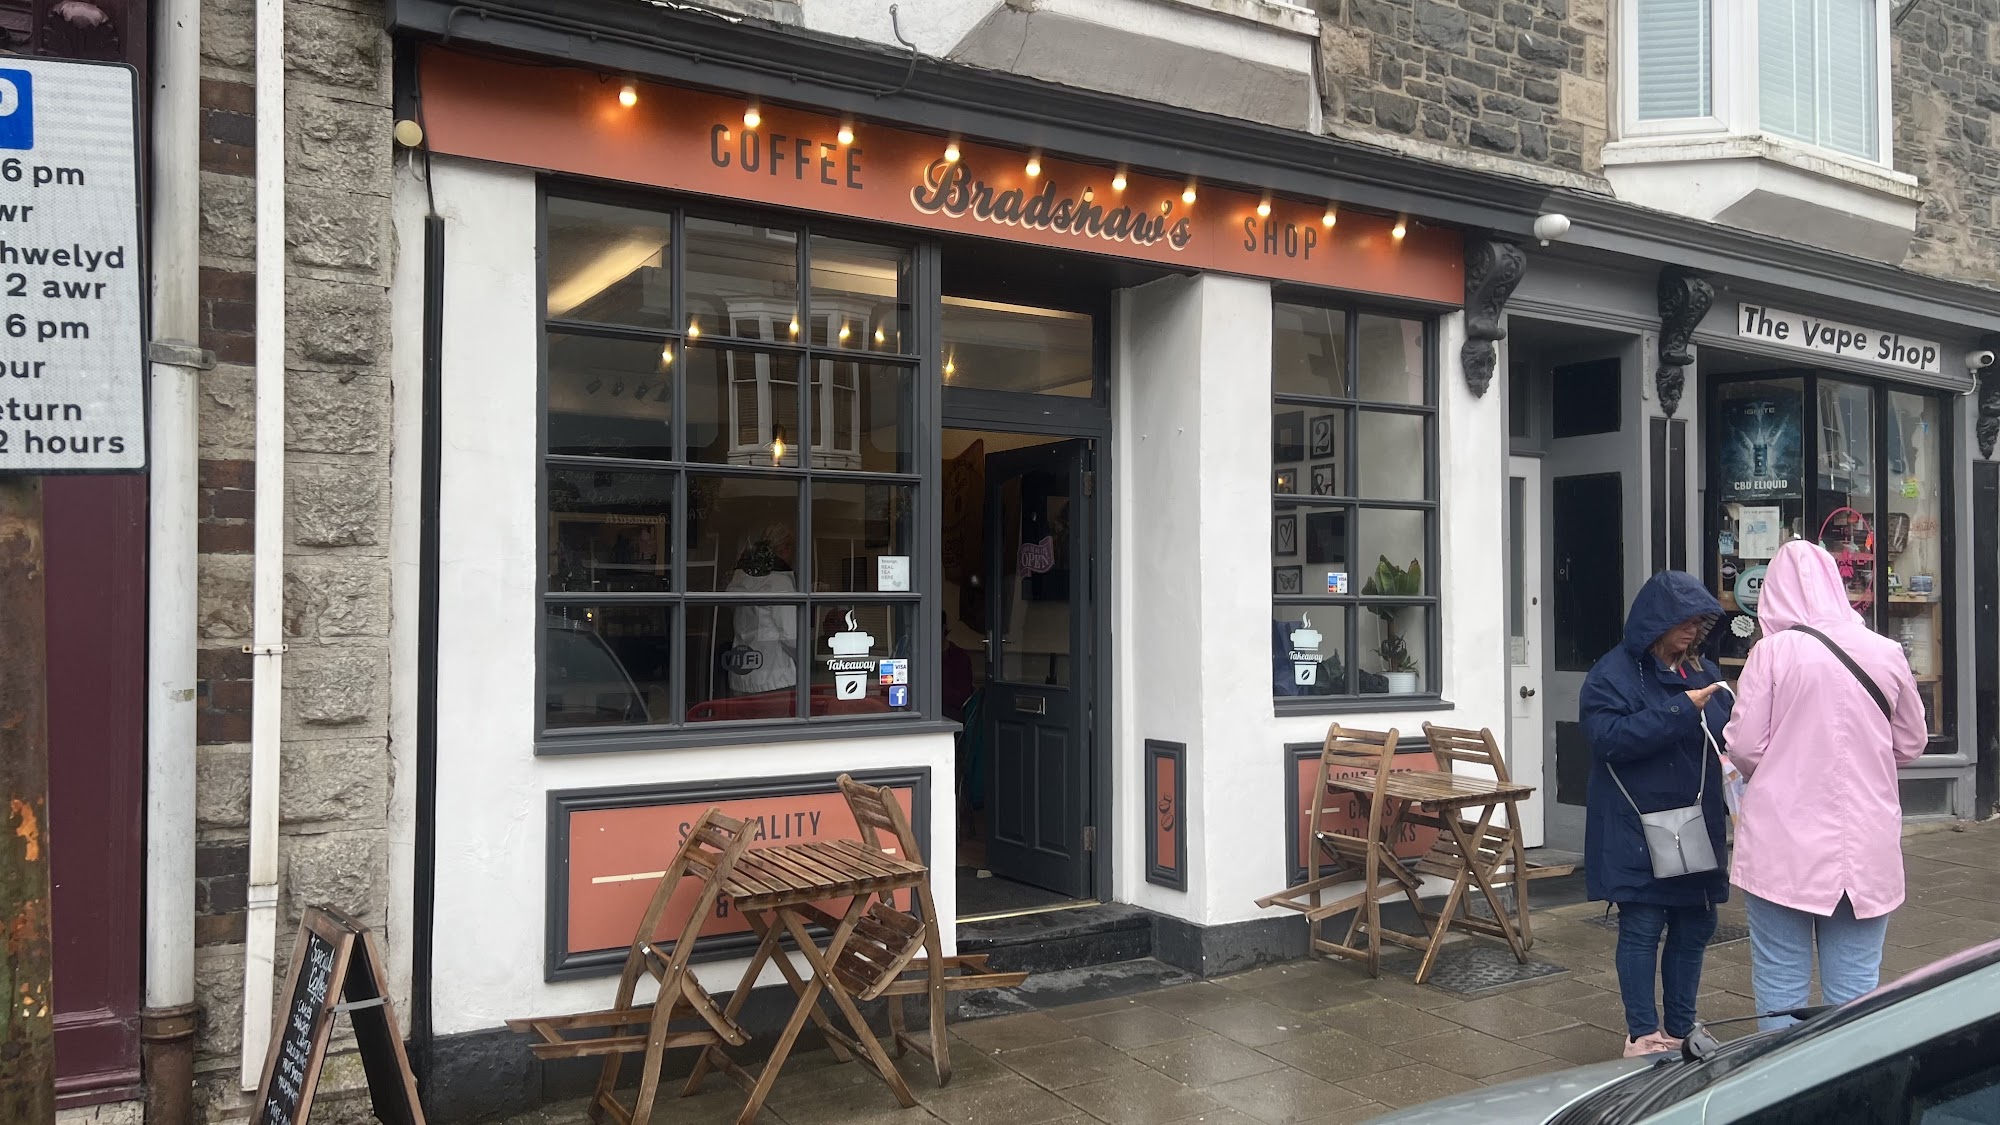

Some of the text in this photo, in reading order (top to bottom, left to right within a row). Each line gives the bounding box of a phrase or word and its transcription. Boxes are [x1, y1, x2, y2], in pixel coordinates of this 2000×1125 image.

[710, 123, 865, 190] COFFEE
[2, 158, 85, 188] 6 pm
[910, 157, 1192, 251] Bradshaw's
[1243, 216, 1318, 261] SHOP
[6, 273, 107, 300] 2 awr
[5, 314, 90, 343] 6 pm
[1744, 306, 1936, 370] The Vape Shop
[0, 397, 82, 421] turn
[25, 429, 125, 454] hours
[1734, 480, 1788, 490] CBD ELIQUID
[1021, 552, 1051, 569] OPEN
[827, 659, 876, 672] Takeaway
[1289, 651, 1323, 662] Takeaway
[679, 811, 822, 848] SALITY
